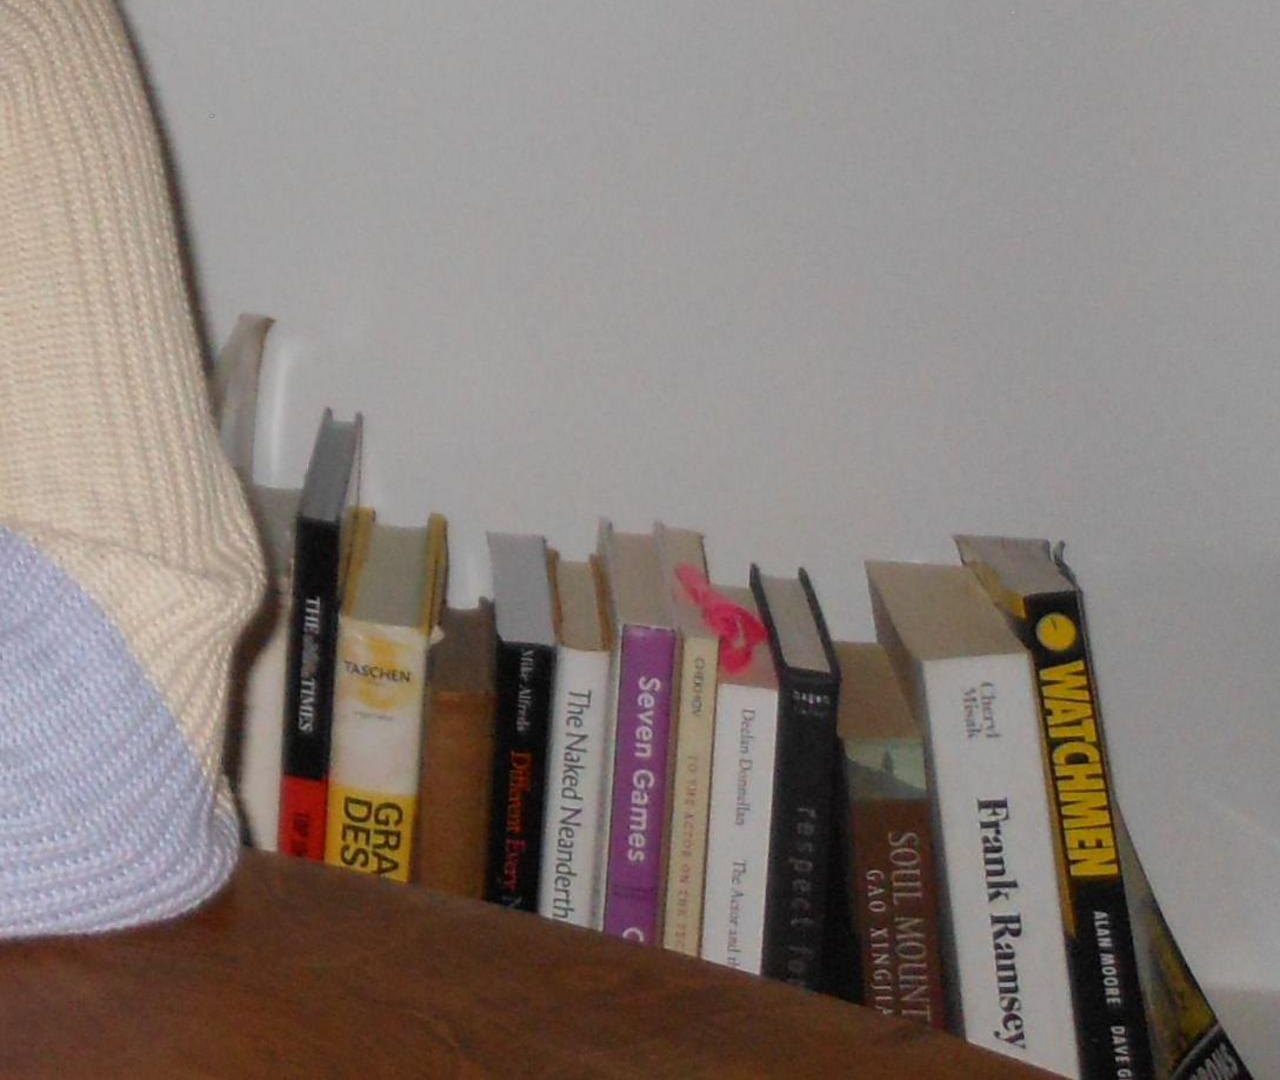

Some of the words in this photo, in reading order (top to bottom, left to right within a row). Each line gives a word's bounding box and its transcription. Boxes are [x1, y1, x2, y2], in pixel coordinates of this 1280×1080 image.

[303, 598, 319, 632] THE
[343, 661, 410, 683] TASCHEN
[299, 678, 318, 731] TIMES
[566, 689, 592, 728] The
[632, 676, 659, 757] Seven
[979, 682, 1000, 739] Cheryl
[506, 750, 530, 834] Different
[561, 733, 589, 800] Naked
[1040, 661, 1118, 877] WATCHMEN
[341, 797, 372, 866] DES
[374, 803, 402, 875] GRA
[627, 769, 653, 862] Games
[502, 839, 526, 891] Every
[730, 860, 747, 885] The
[789, 806, 816, 928] respect
[887, 831, 922, 905] SOUL
[976, 797, 1017, 900] Frank
[727, 889, 744, 924] Actor
[1093, 911, 1115, 947] ALAN
[726, 927, 741, 953] and
[888, 916, 931, 1021] MOUNT
[984, 912, 1028, 1050] Ramsey
[1098, 953, 1122, 1004] MOORE
[1111, 1026, 1130, 1063] DAVE
